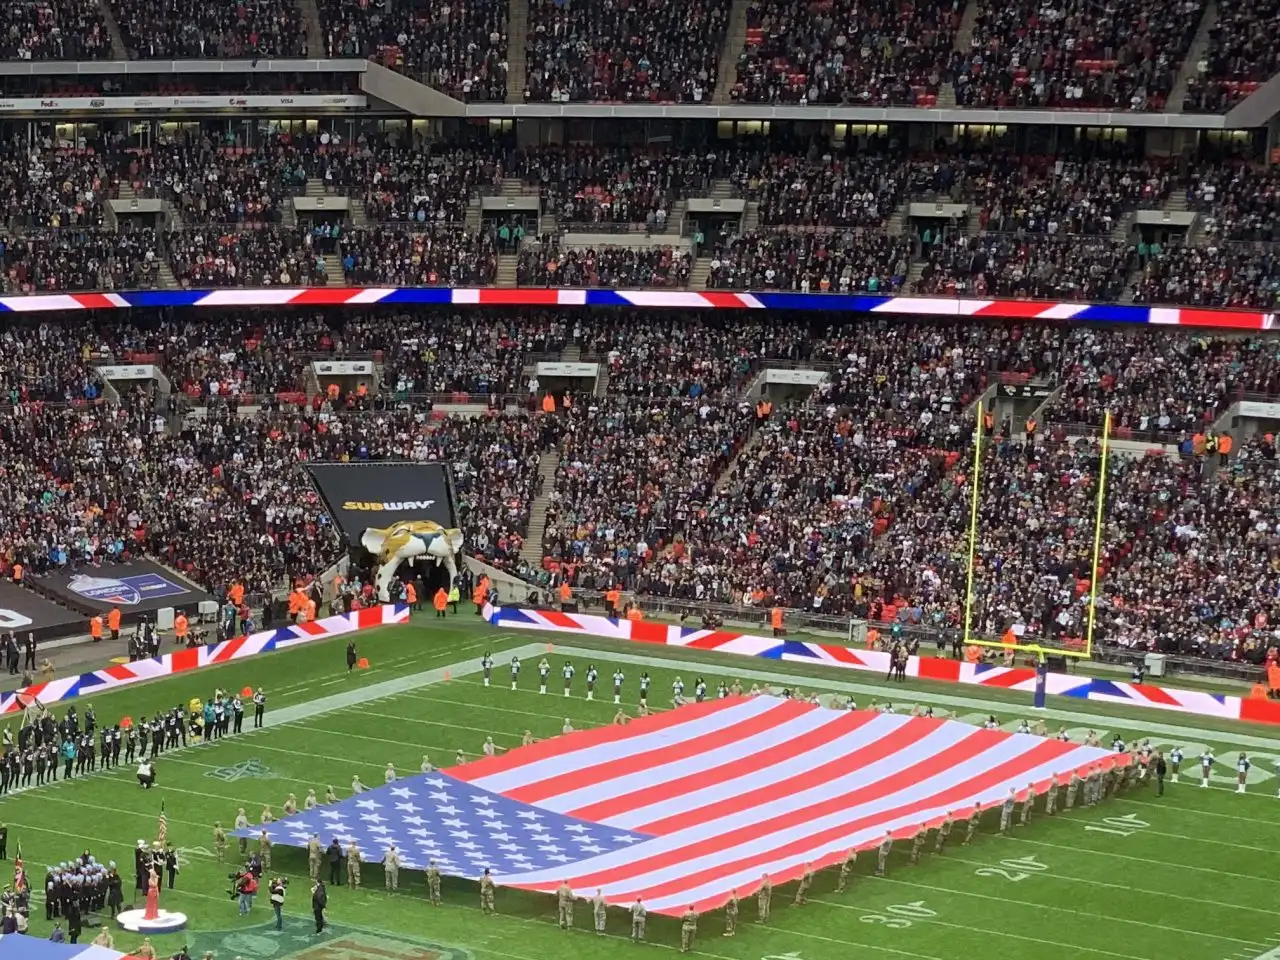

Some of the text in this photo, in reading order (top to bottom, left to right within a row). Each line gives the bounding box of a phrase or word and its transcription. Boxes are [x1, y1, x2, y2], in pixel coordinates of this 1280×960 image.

[40, 100, 59, 108] FedEx
[342, 499, 435, 512] SUBWAY
[83, 585, 130, 597] LONDON
